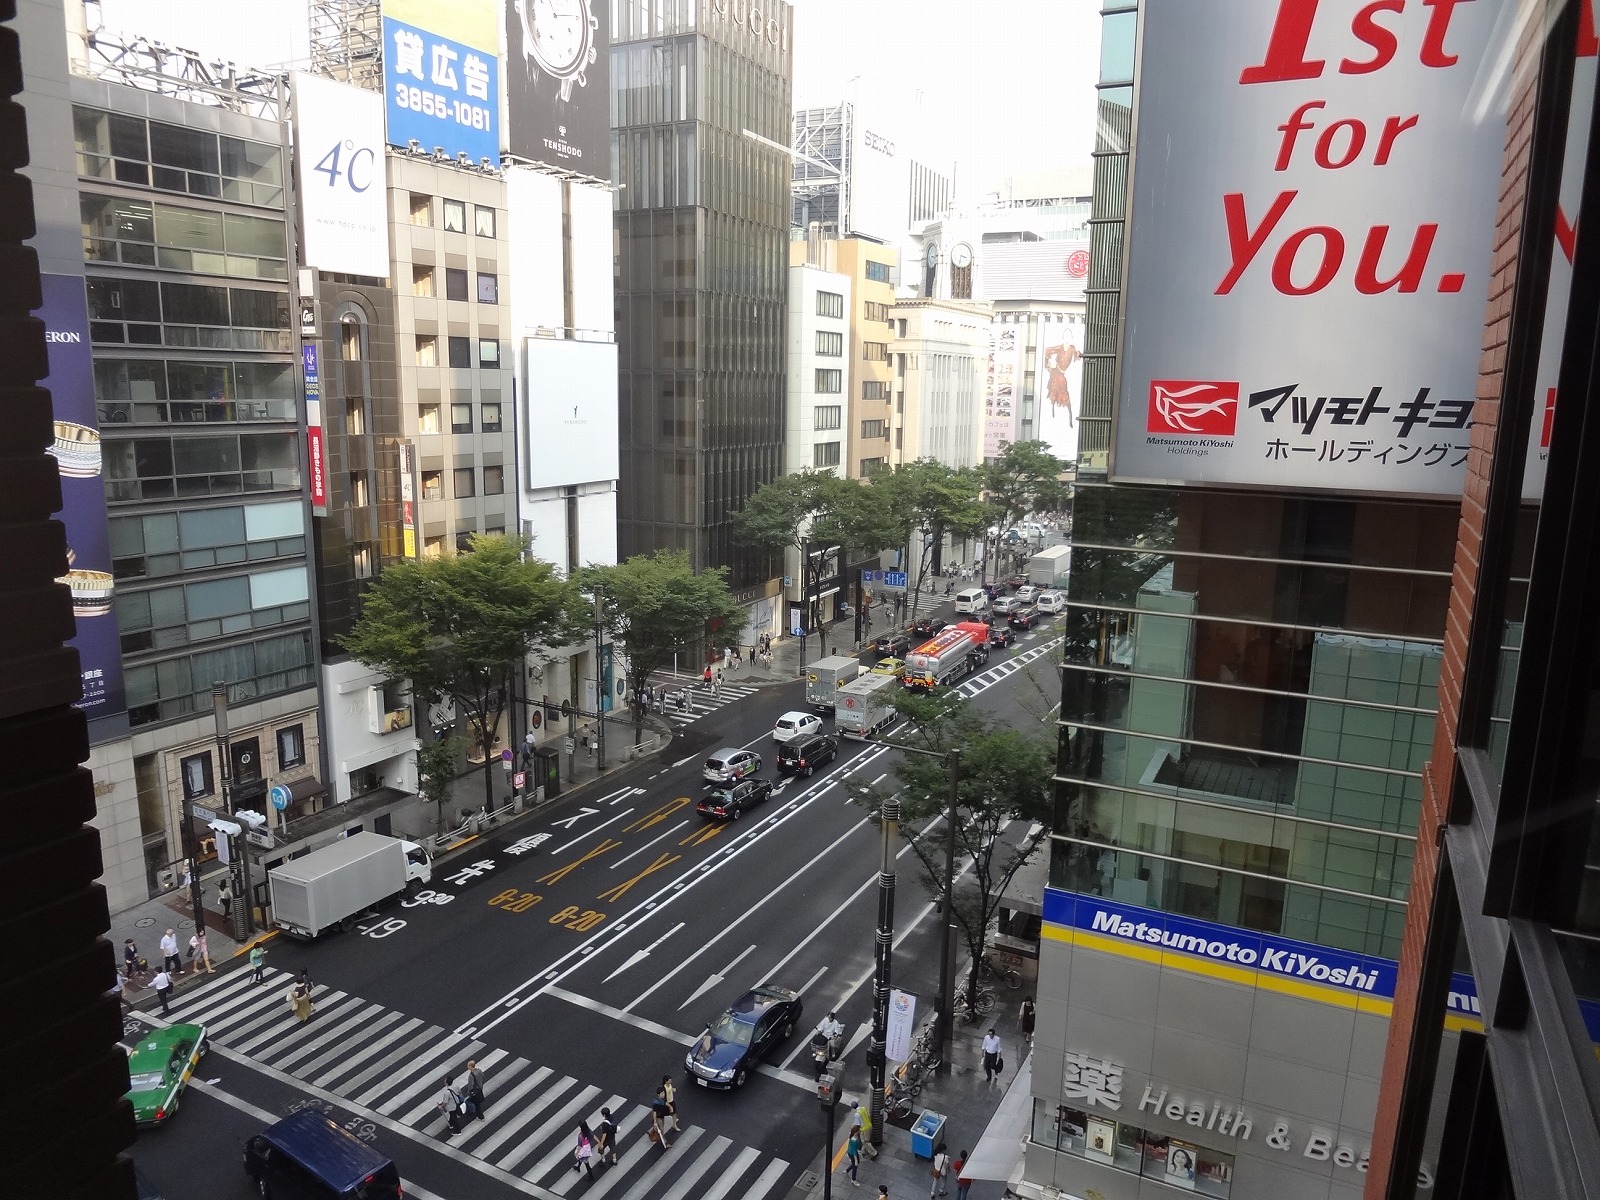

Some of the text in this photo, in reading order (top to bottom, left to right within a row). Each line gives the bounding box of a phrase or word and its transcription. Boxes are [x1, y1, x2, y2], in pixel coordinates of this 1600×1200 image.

[394, 29, 490, 100] 貸広告
[1239, 0, 1475, 84] 1st
[395, 83, 490, 132] 3855-1081
[1274, 99, 1420, 171] for
[542, 138, 583, 158] TENSHODO
[864, 129, 896, 157] SEIKO
[1215, 189, 1466, 296] You.
[1248, 383, 1474, 438] マツモトキヨ
[1146, 436, 1234, 449] Matsumoto KiYoshi
[1166, 446, 1210, 458] Holdings
[487, 888, 544, 913] 8-20
[548, 905, 608, 932] 8-20
[1091, 910, 1379, 991] Matsumoto KiYoshi
[1063, 1052, 1125, 1112] 薬
[1138, 1085, 1254, 1141] Health
[1265, 1121, 1293, 1151] &
